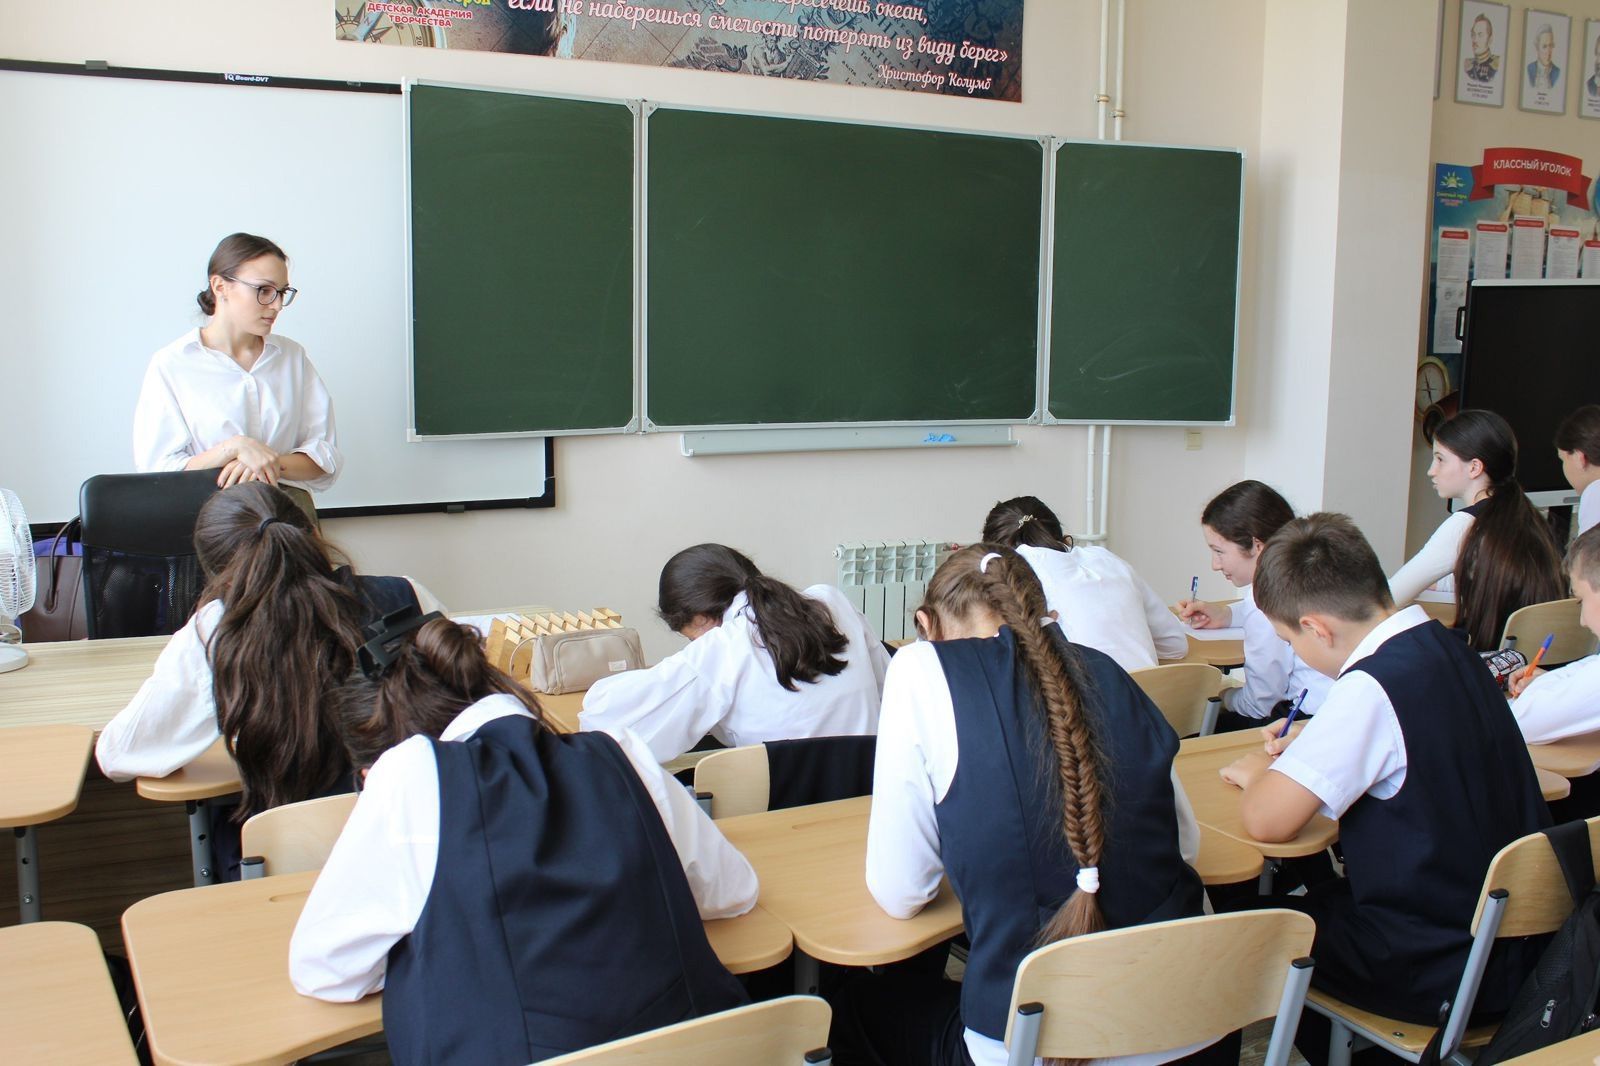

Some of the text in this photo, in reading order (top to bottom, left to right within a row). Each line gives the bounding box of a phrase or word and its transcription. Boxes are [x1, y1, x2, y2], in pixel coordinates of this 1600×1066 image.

[367, 3, 473, 19] ДЕТСКАЯ АКАДЕМИЯ
[389, 14, 452, 27] ТВОРЧЕСТВА
[876, 3, 928, 25] океан,
[508, 0, 1008, 68] если не наберешься смелости потерять из виду берег»
[877, 64, 945, 90] Христофор
[948, 72, 992, 94] Колумб
[1493, 158, 1573, 177] КЛАССНЫЙ УГОЛОК
